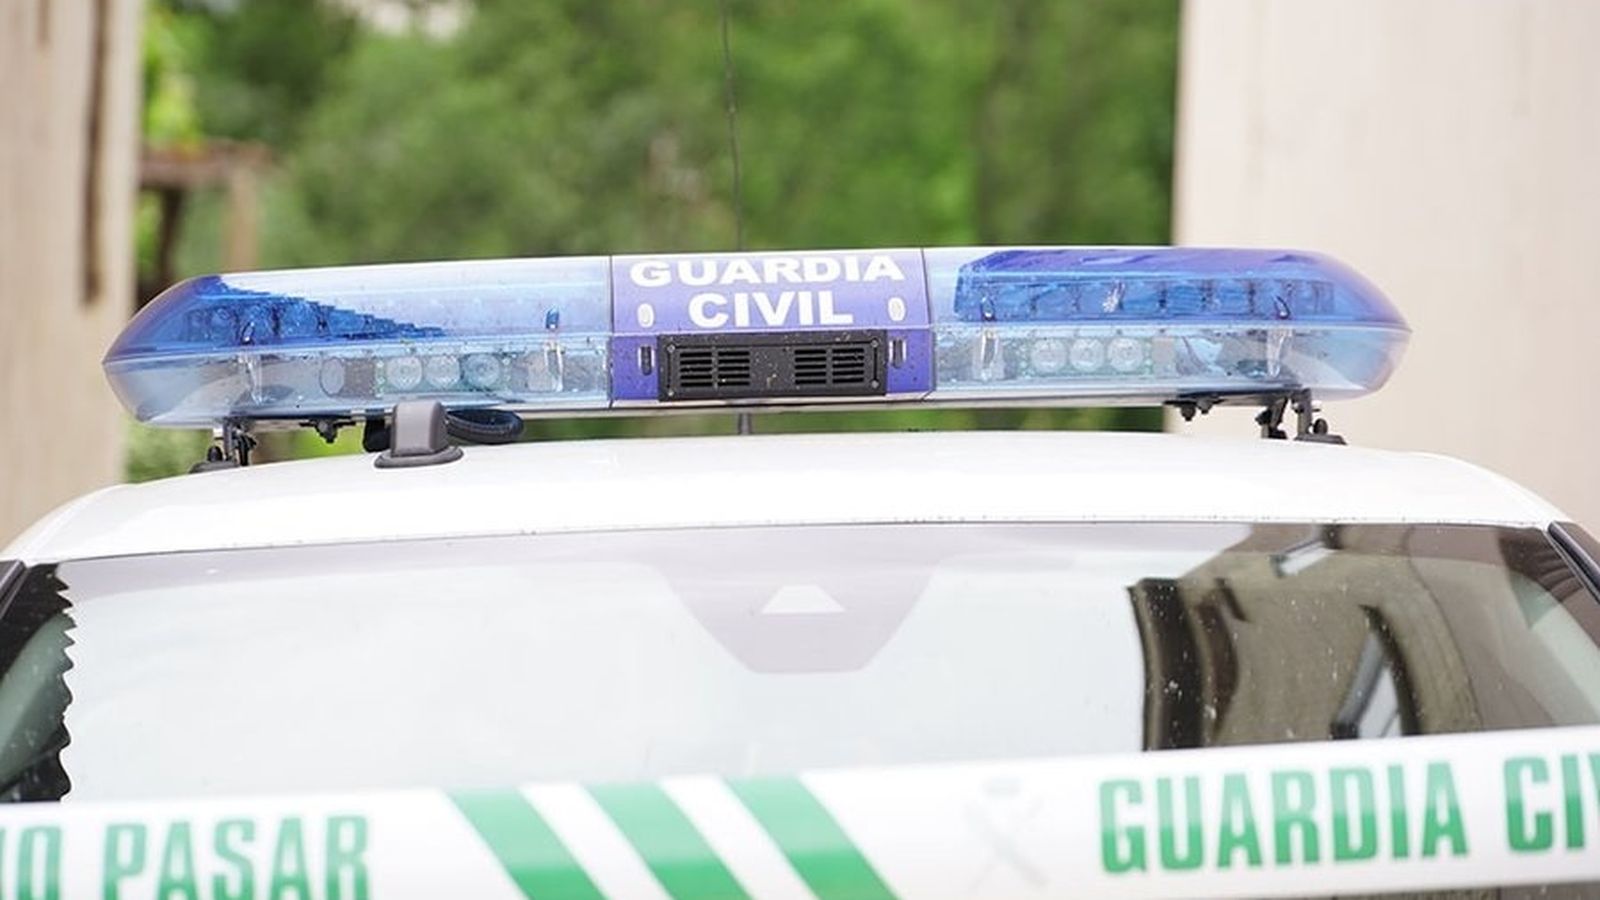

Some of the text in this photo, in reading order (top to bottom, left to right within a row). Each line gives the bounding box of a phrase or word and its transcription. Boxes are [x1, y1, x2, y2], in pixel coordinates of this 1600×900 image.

[630, 255, 904, 287] GUARDIA
[689, 291, 853, 327] CIVIL
[1099, 754, 1600, 873] GUARDIA CI
[0, 815, 370, 900] O PASAR
